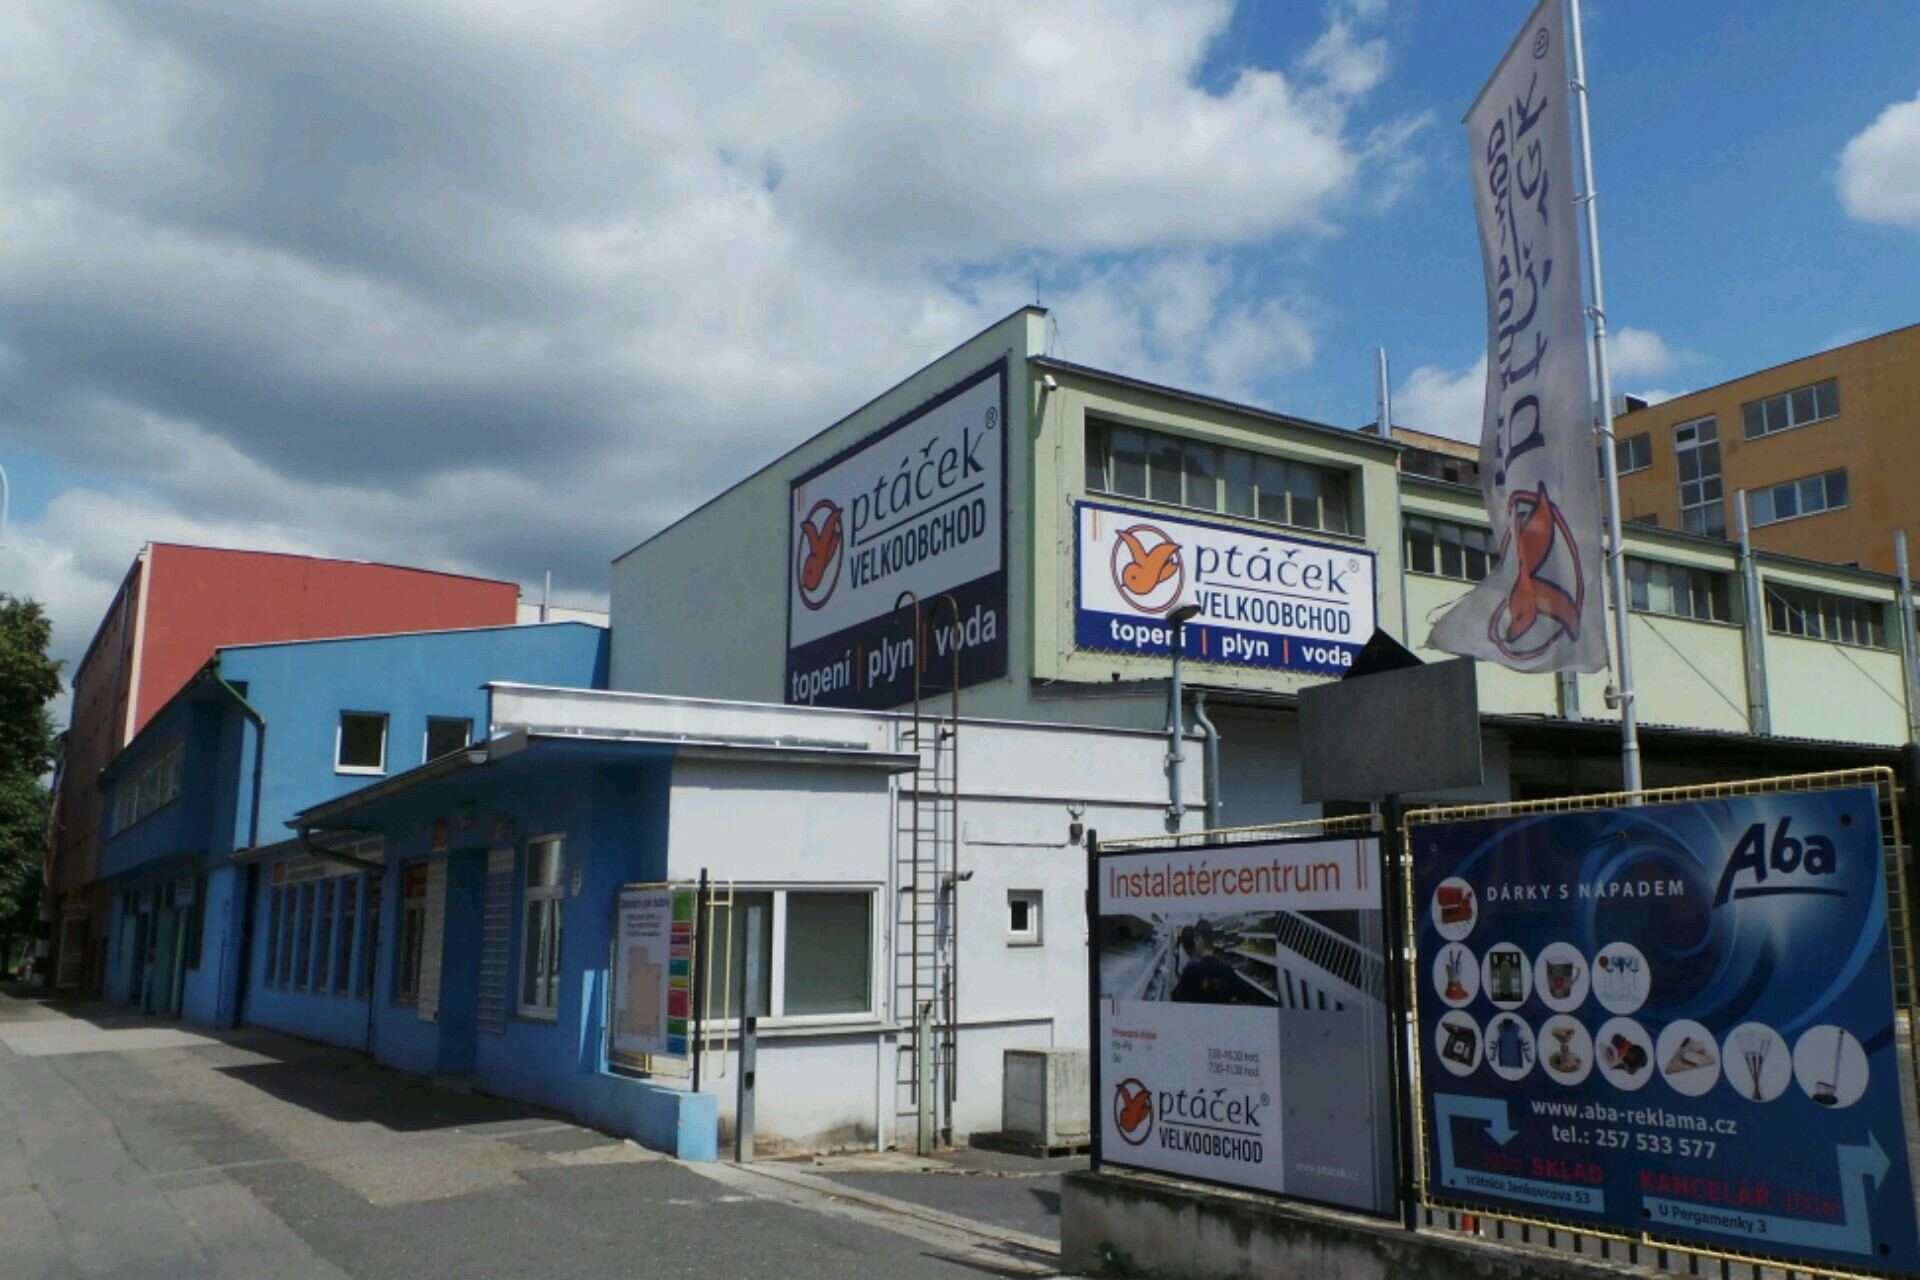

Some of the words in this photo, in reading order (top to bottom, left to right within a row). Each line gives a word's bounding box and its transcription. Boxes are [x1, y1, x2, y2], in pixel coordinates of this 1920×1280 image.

[851, 427, 985, 548] ptáček
[850, 497, 986, 589] VELKOOBCHOD
[1195, 545, 1349, 595] ptáček
[1195, 590, 1351, 635] VELKOOBCHOD
[791, 649, 851, 705] topení
[868, 637, 914, 688] plyn
[935, 604, 997, 657] voda
[1222, 633, 1269, 660] plyn
[1302, 645, 1352, 667] voda
[1109, 859, 1340, 899] Instalatércentrum
[1712, 816, 1836, 908] Aba
[1486, 882, 1551, 901] DÁRKY
[1559, 884, 1570, 899] S
[1159, 1088, 1261, 1127] ptáček
[1531, 1100, 1738, 1135] www.aba-reklama.cz
[1159, 1127, 1263, 1164] VELKOOBCHOD
[1552, 1124, 1590, 1144] tel.:
[1596, 1128, 1630, 1149] 257
[1636, 1133, 1673, 1155] 533
[1679, 1138, 1716, 1160] 577
[1531, 1156, 1604, 1184] SKLAD
[1640, 1170, 1771, 1209] KANCELÁŘ
[1575, 1191, 1591, 1205] 53
[1658, 1203, 1669, 1216] U
[1672, 1205, 1754, 1233] Pergamenky
[1757, 1219, 1768, 1233] 3
